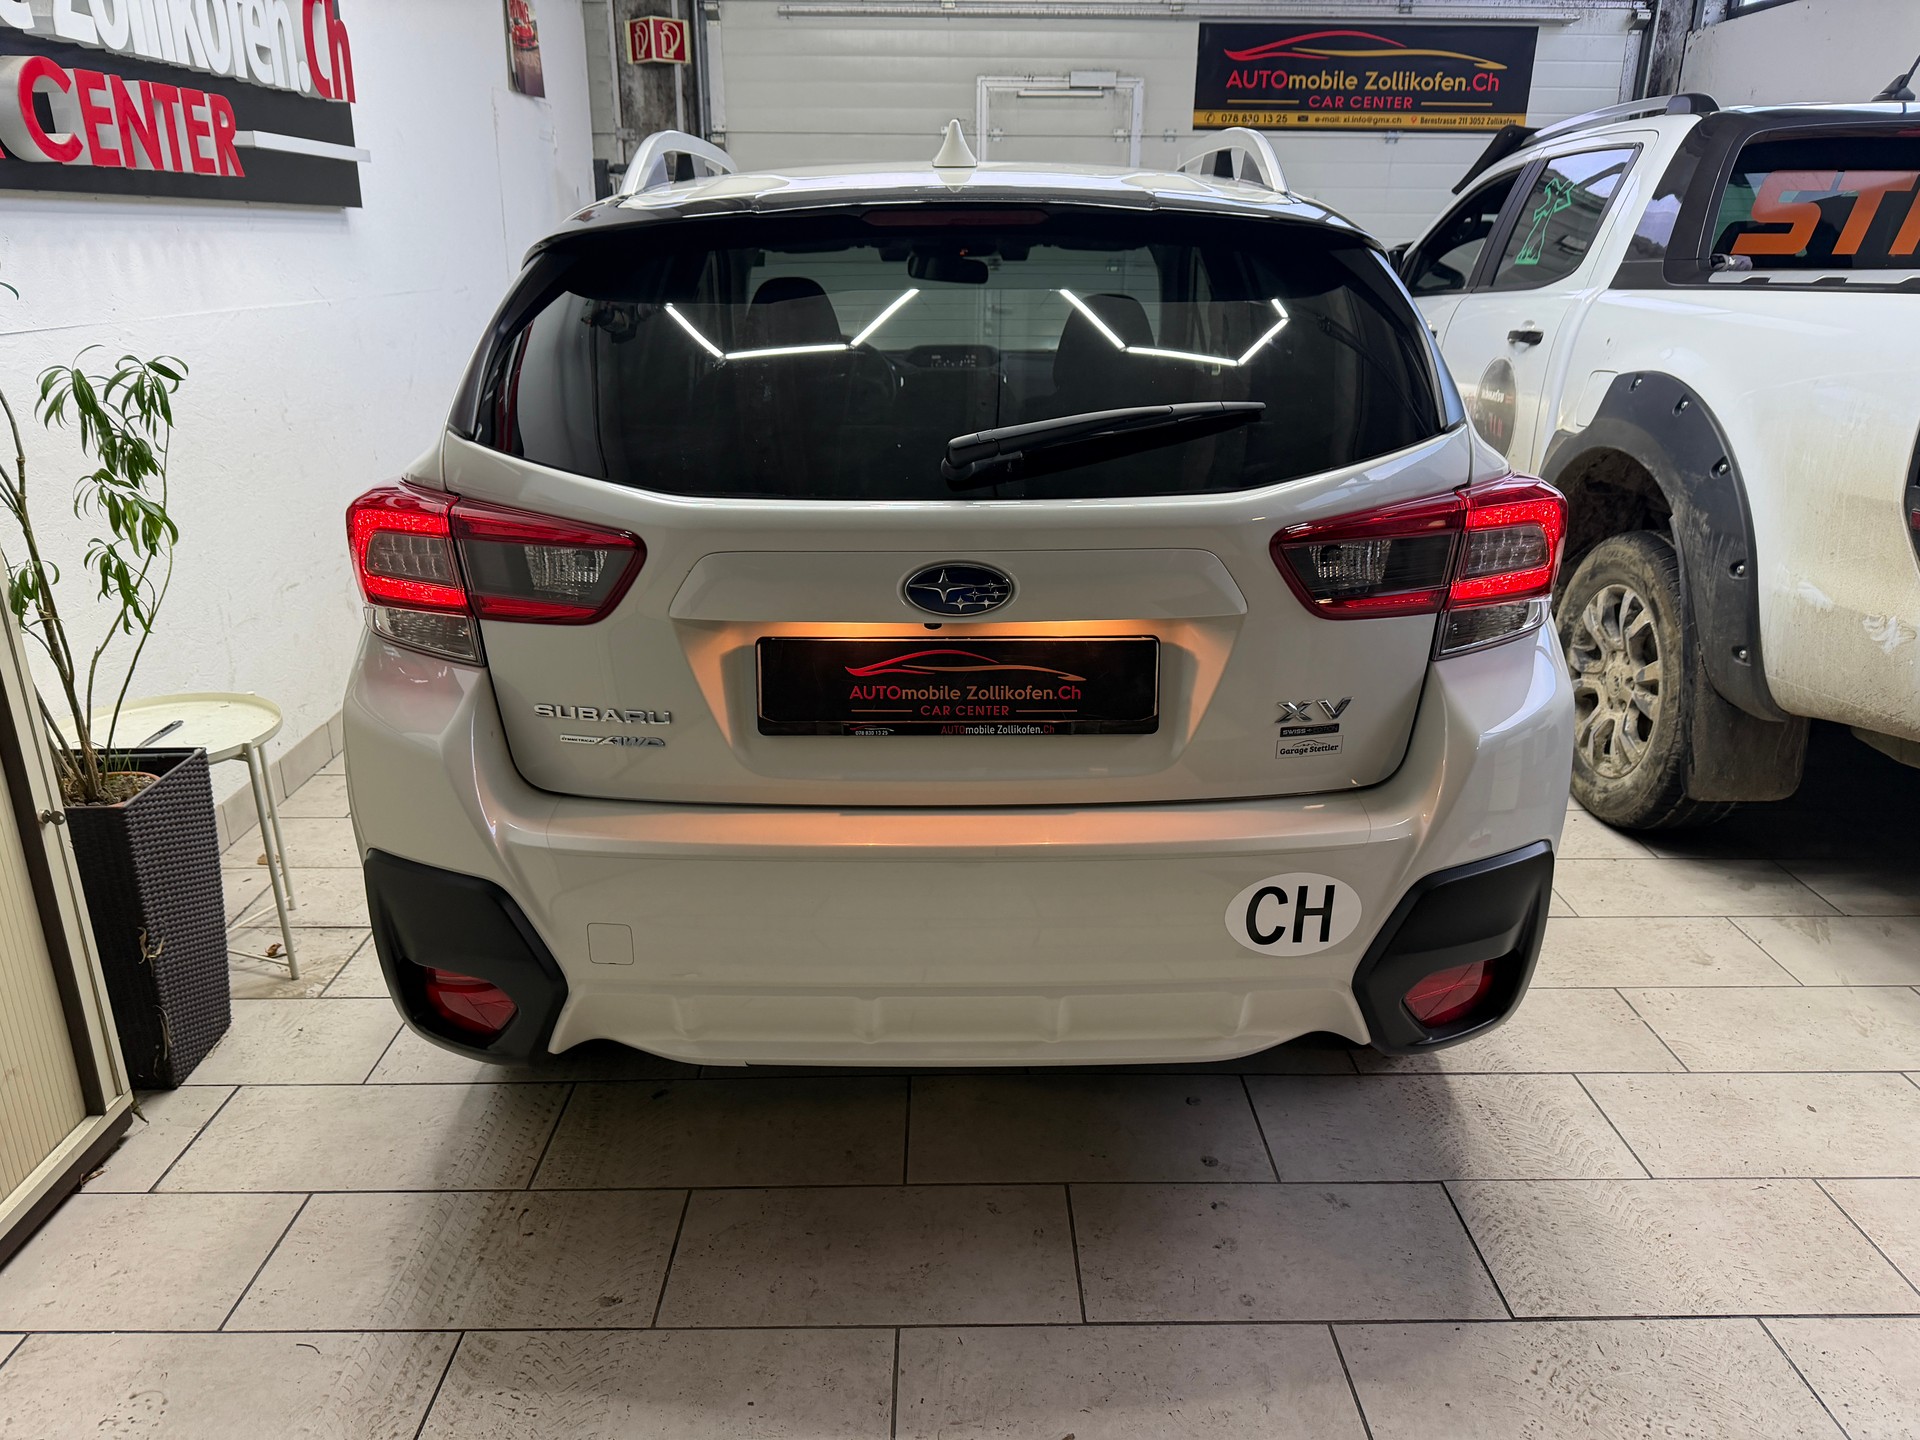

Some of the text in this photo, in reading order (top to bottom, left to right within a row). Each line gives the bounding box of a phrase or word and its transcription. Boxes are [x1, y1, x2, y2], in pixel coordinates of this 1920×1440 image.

[1226, 70, 1500, 92] AUTOmobile Zollikofen.Ch
[1308, 95, 1413, 109] CAR CENTER
[19, 56, 245, 177] CENTER
[1221, 114, 1238, 122] 078
[1263, 114, 1275, 123] 13
[1276, 114, 1288, 123] 25
[1420, 116, 1457, 124] Bernstrasse
[1469, 117, 1485, 125] 3052
[850, 685, 1081, 700] AUTOmobile Zollikofen.Ch
[533, 703, 672, 725] SUBARU
[920, 705, 1009, 716] CAR CENTER
[1275, 697, 1355, 723] XV
[941, 725, 1055, 734] AUTOmobile Zollikofen.Ch
[1282, 728, 1307, 736] SWISS
[597, 735, 666, 747] AWD
[1309, 744, 1339, 753] Stettler
[1246, 884, 1336, 945] CH
